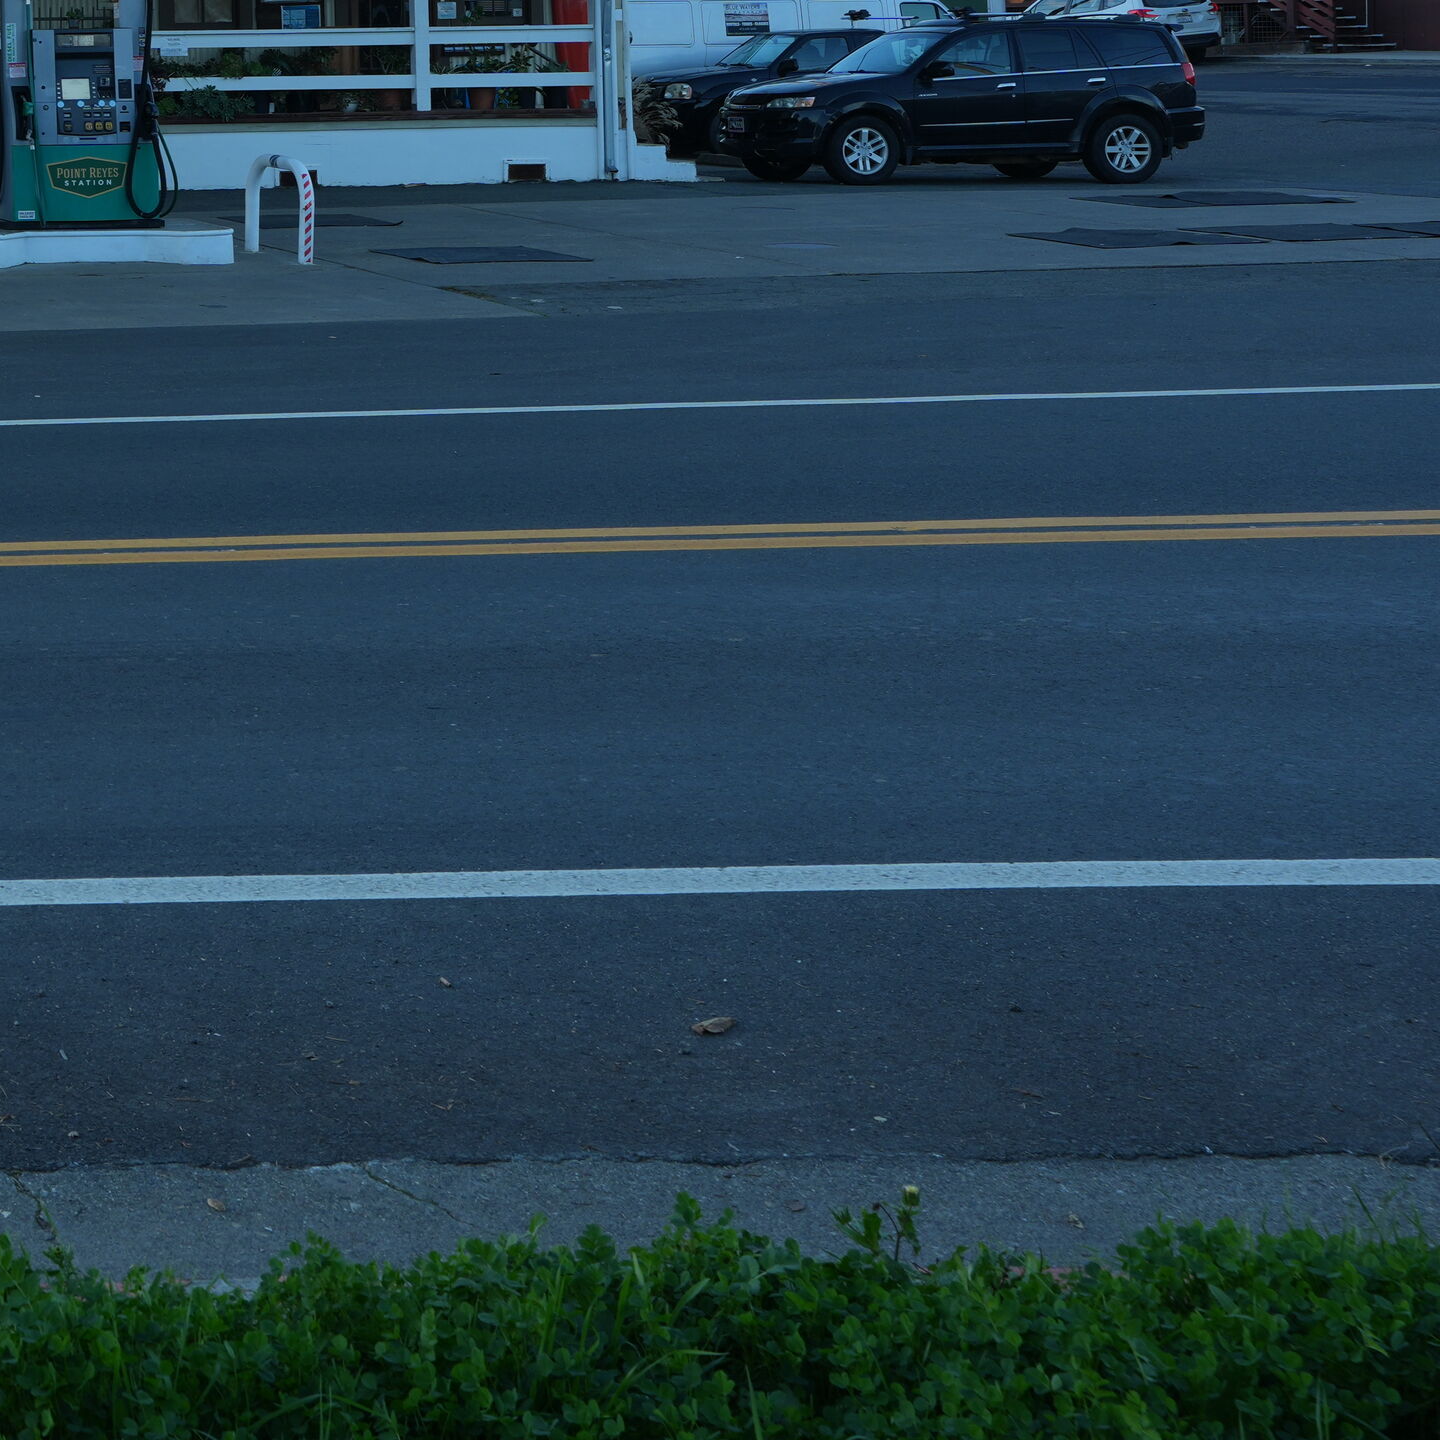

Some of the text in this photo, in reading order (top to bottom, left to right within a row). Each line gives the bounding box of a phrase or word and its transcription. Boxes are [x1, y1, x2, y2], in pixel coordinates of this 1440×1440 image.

[56, 166, 119, 179] POINT REYES
[64, 179, 112, 187] STATION
